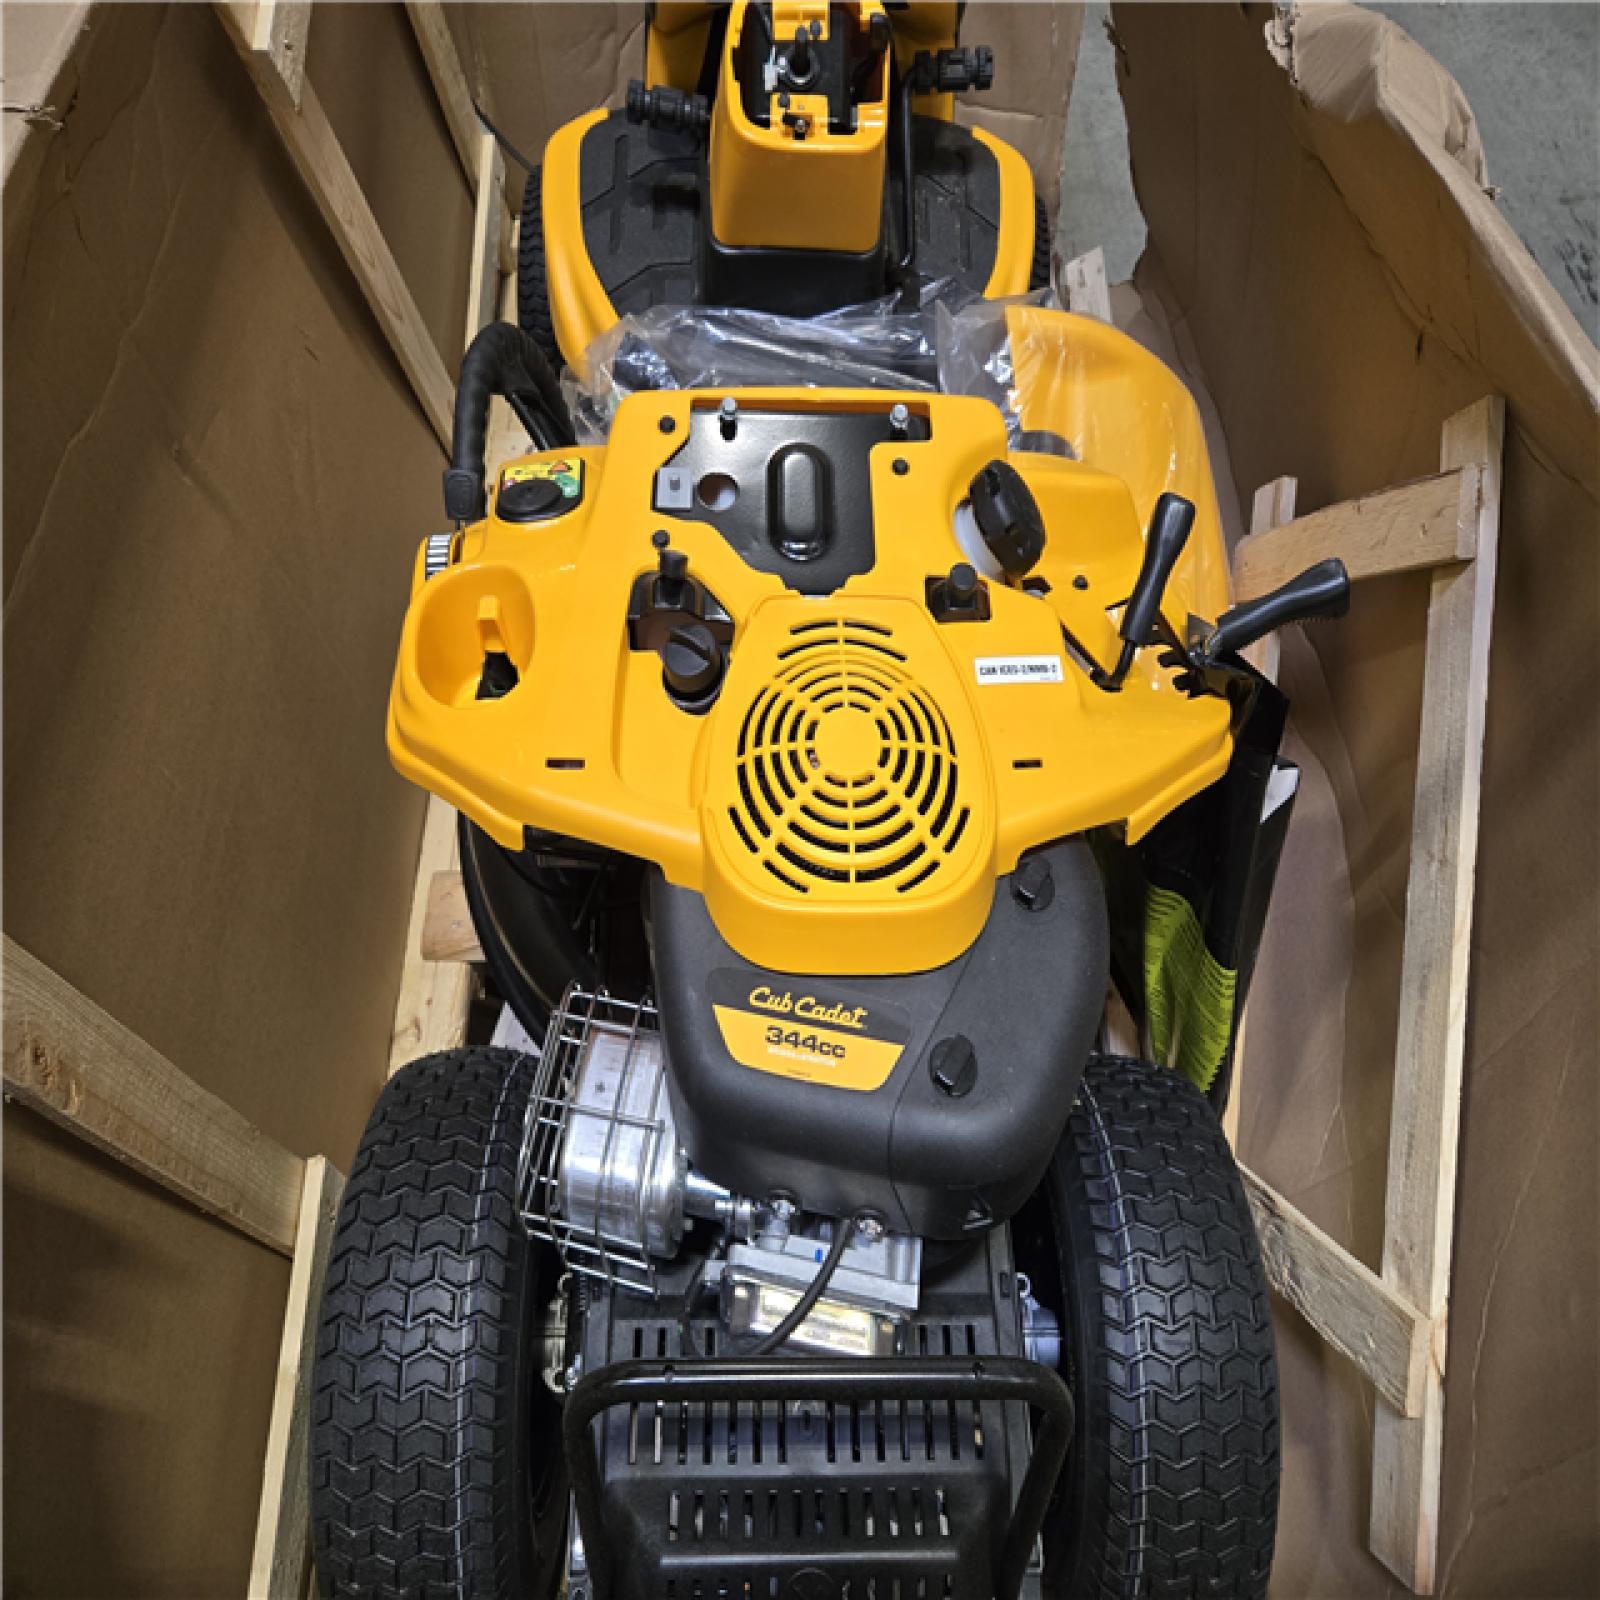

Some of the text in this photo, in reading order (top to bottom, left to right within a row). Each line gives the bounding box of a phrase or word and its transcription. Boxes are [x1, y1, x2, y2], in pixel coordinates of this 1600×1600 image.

[749, 985, 868, 1029] Cub Cadet
[765, 1025, 845, 1058] 344cc
